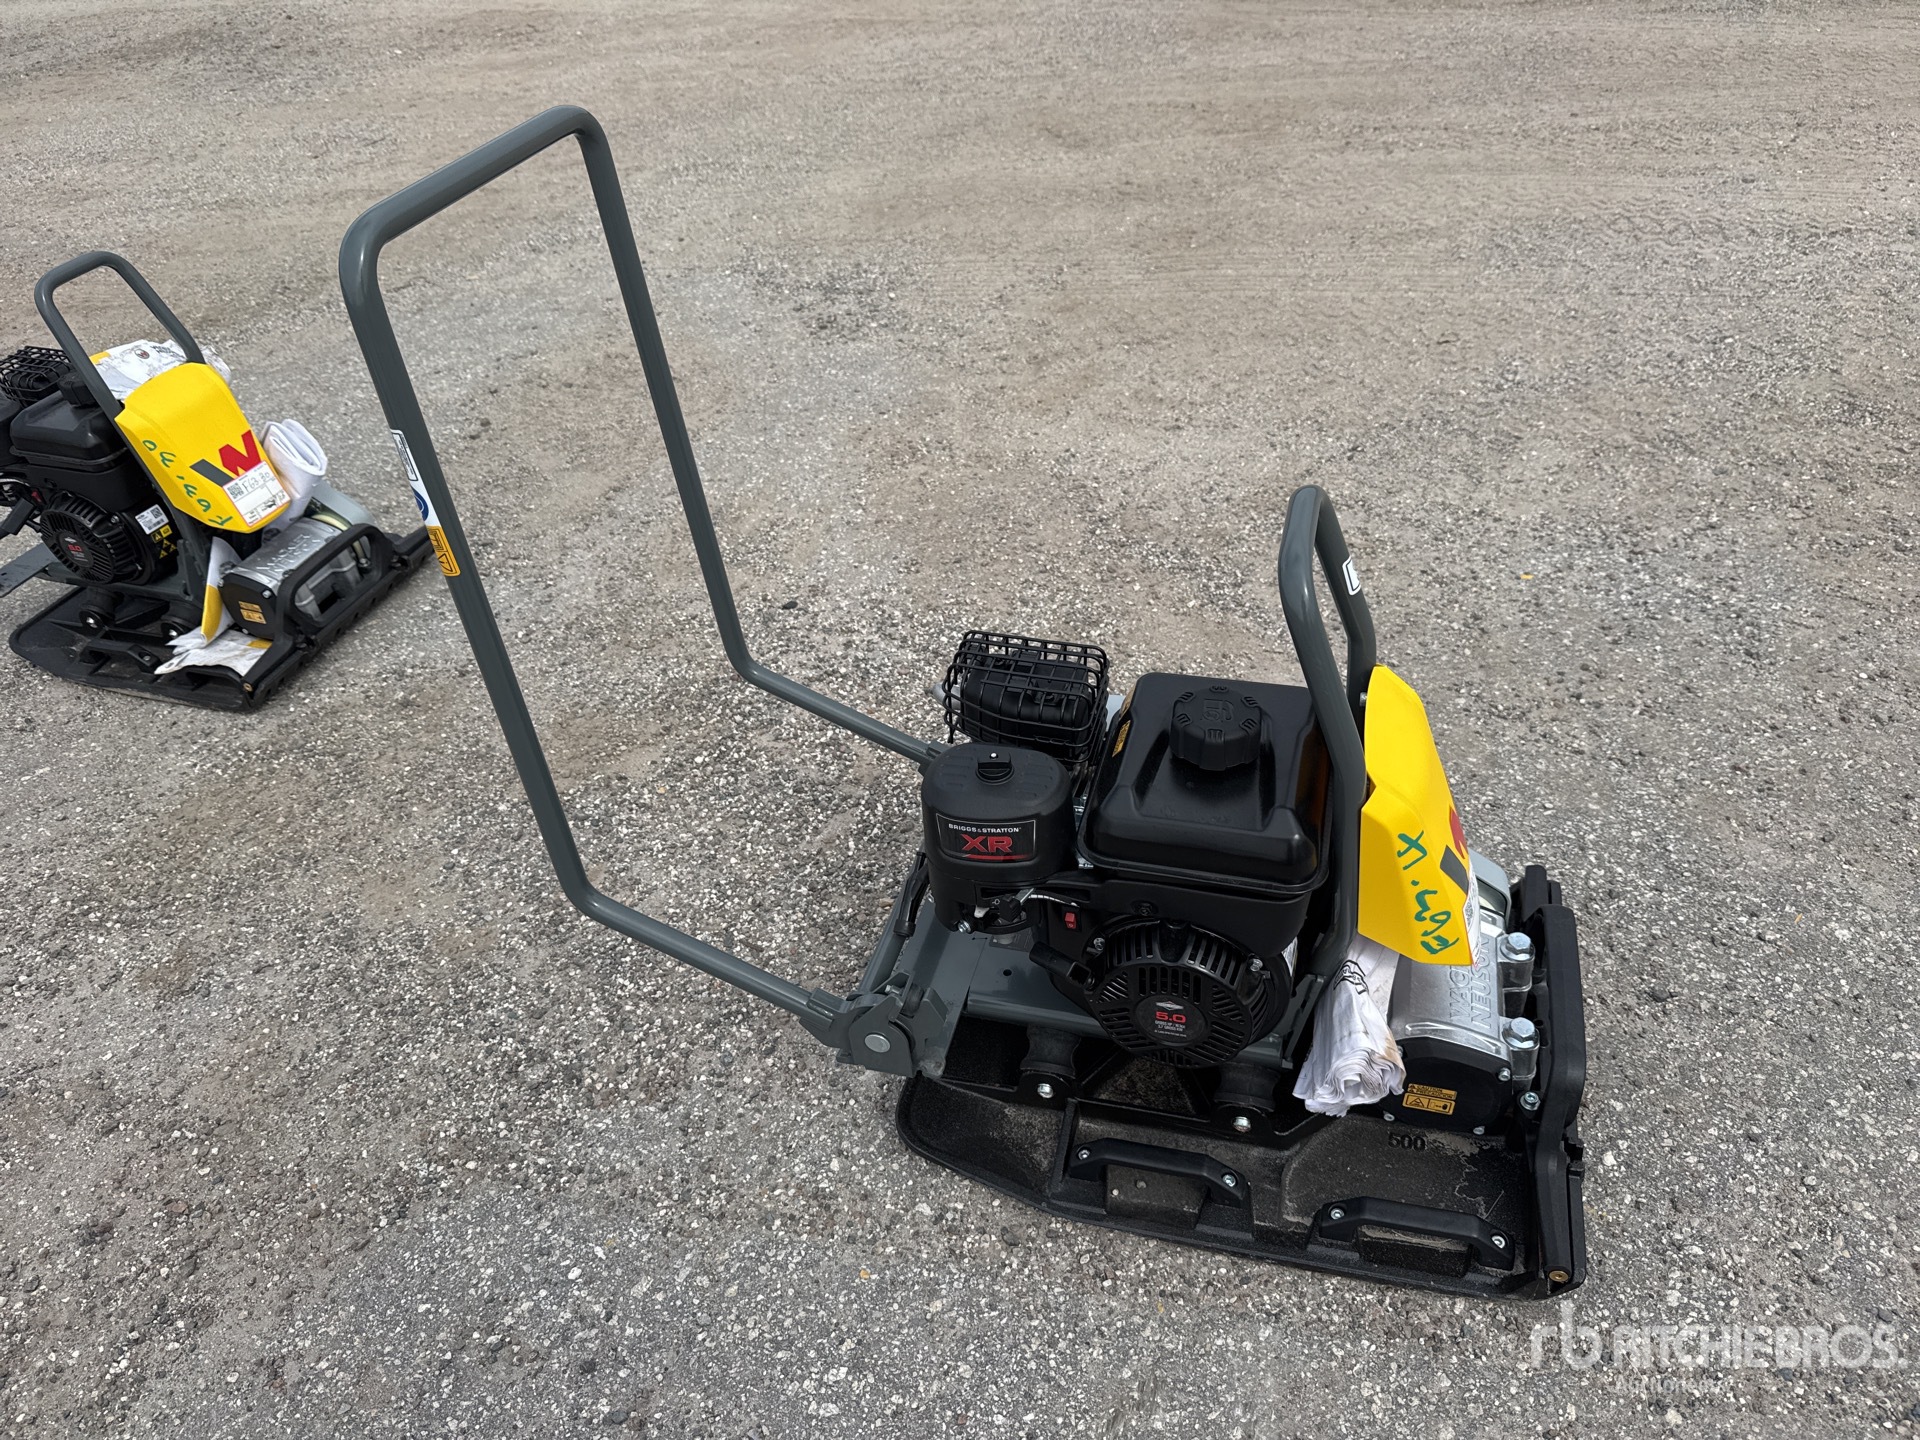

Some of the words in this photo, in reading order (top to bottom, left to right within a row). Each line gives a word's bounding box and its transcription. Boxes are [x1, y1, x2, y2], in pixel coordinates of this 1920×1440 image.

[960, 833, 1013, 853] XR
[1156, 1011, 1187, 1023] 5.0
[1388, 1131, 1426, 1151] 500
